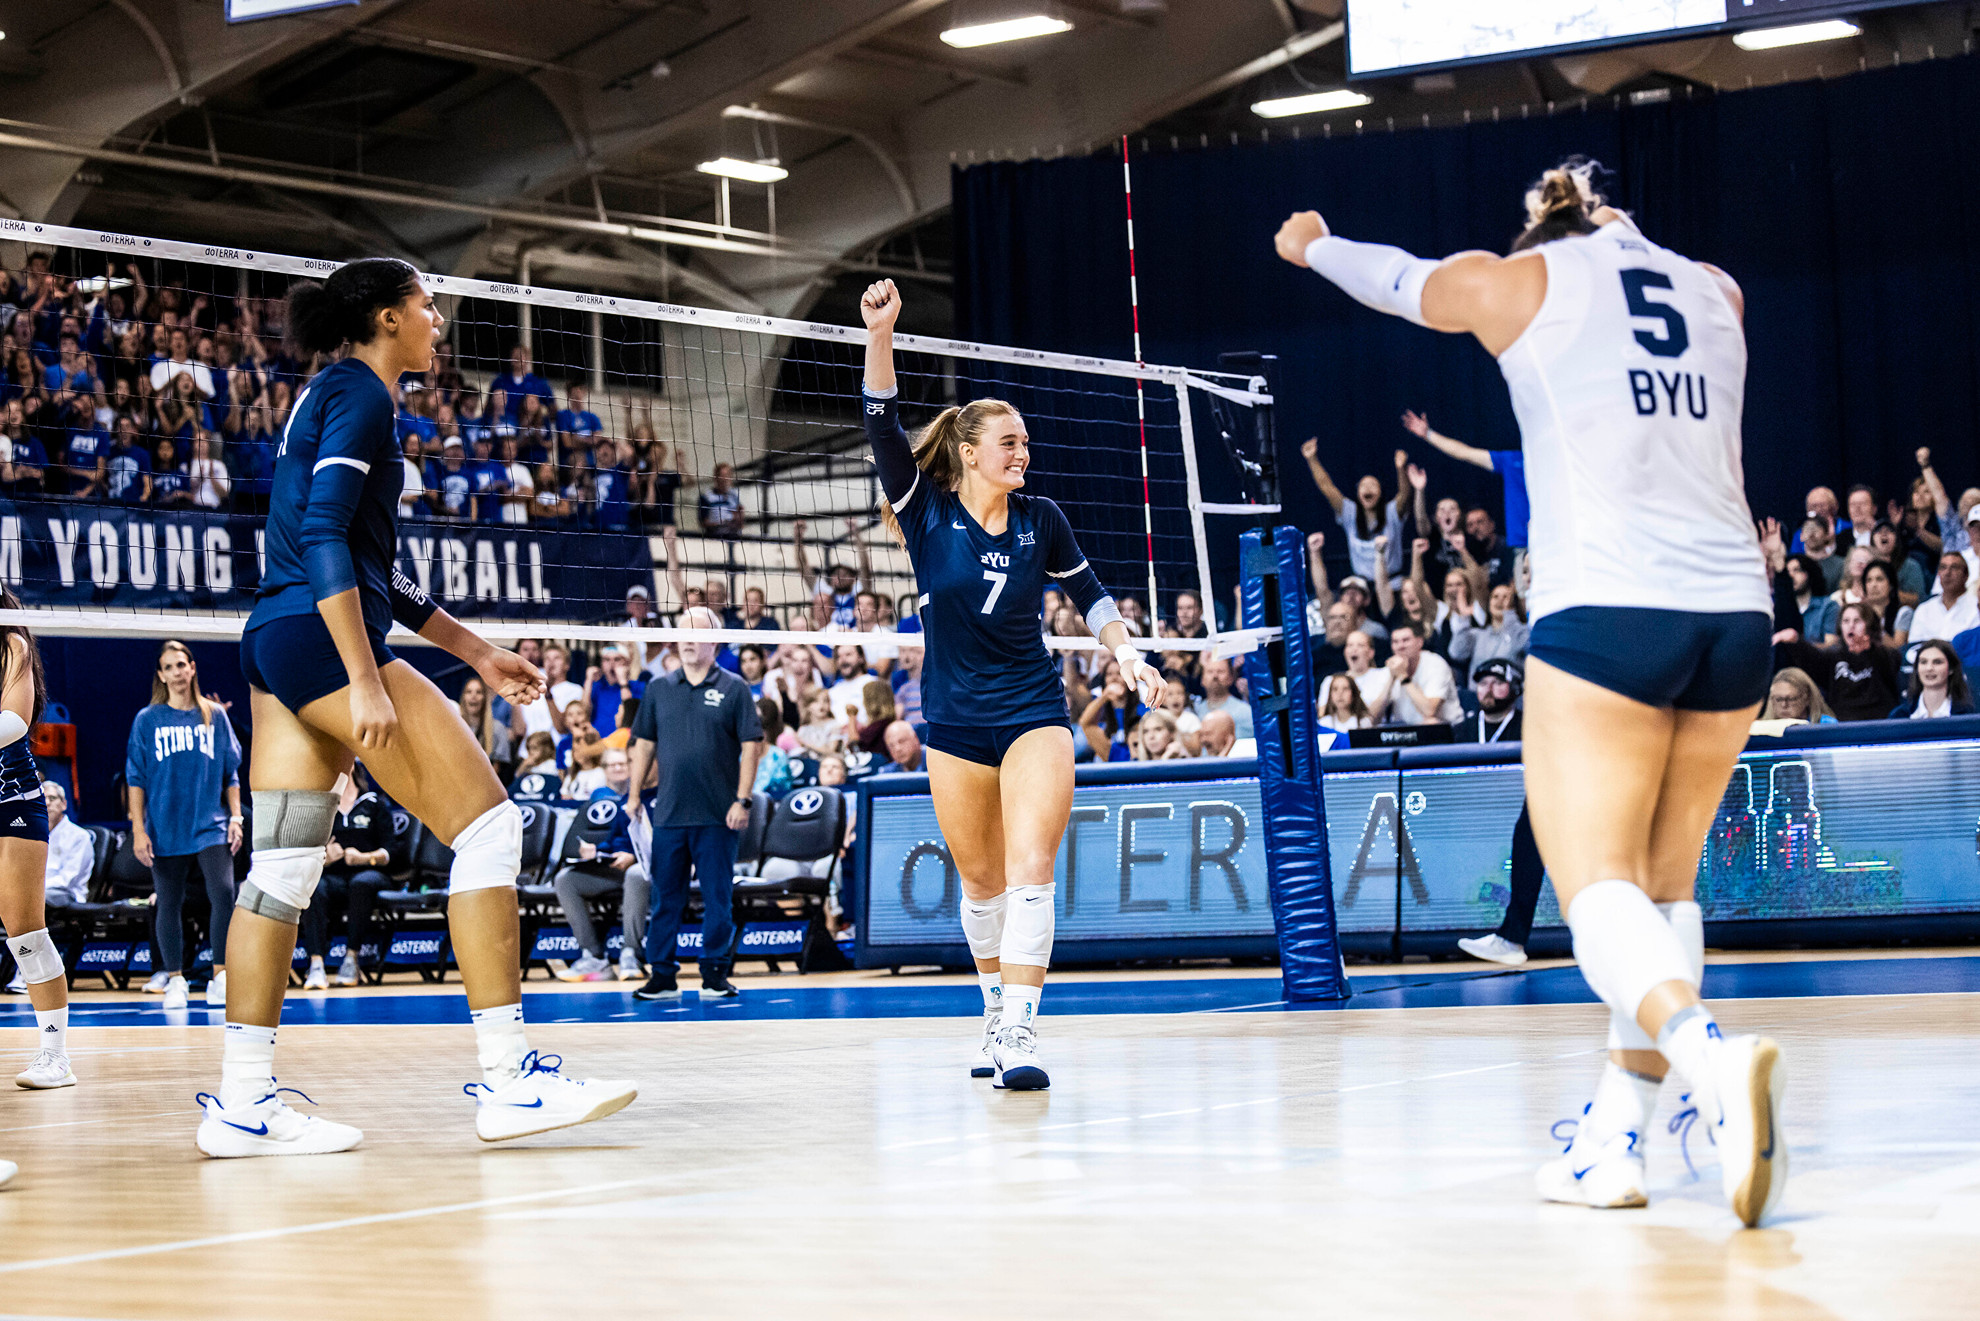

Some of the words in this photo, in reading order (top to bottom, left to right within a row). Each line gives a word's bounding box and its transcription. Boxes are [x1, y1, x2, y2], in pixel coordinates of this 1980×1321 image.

[1618, 267, 1690, 359] 5
[1628, 368, 1708, 421] BYU
[47, 518, 234, 594] YOUNG
[391, 567, 428, 606] OUGARS
[980, 569, 1008, 615] 7
[154, 726, 194, 762] STING
